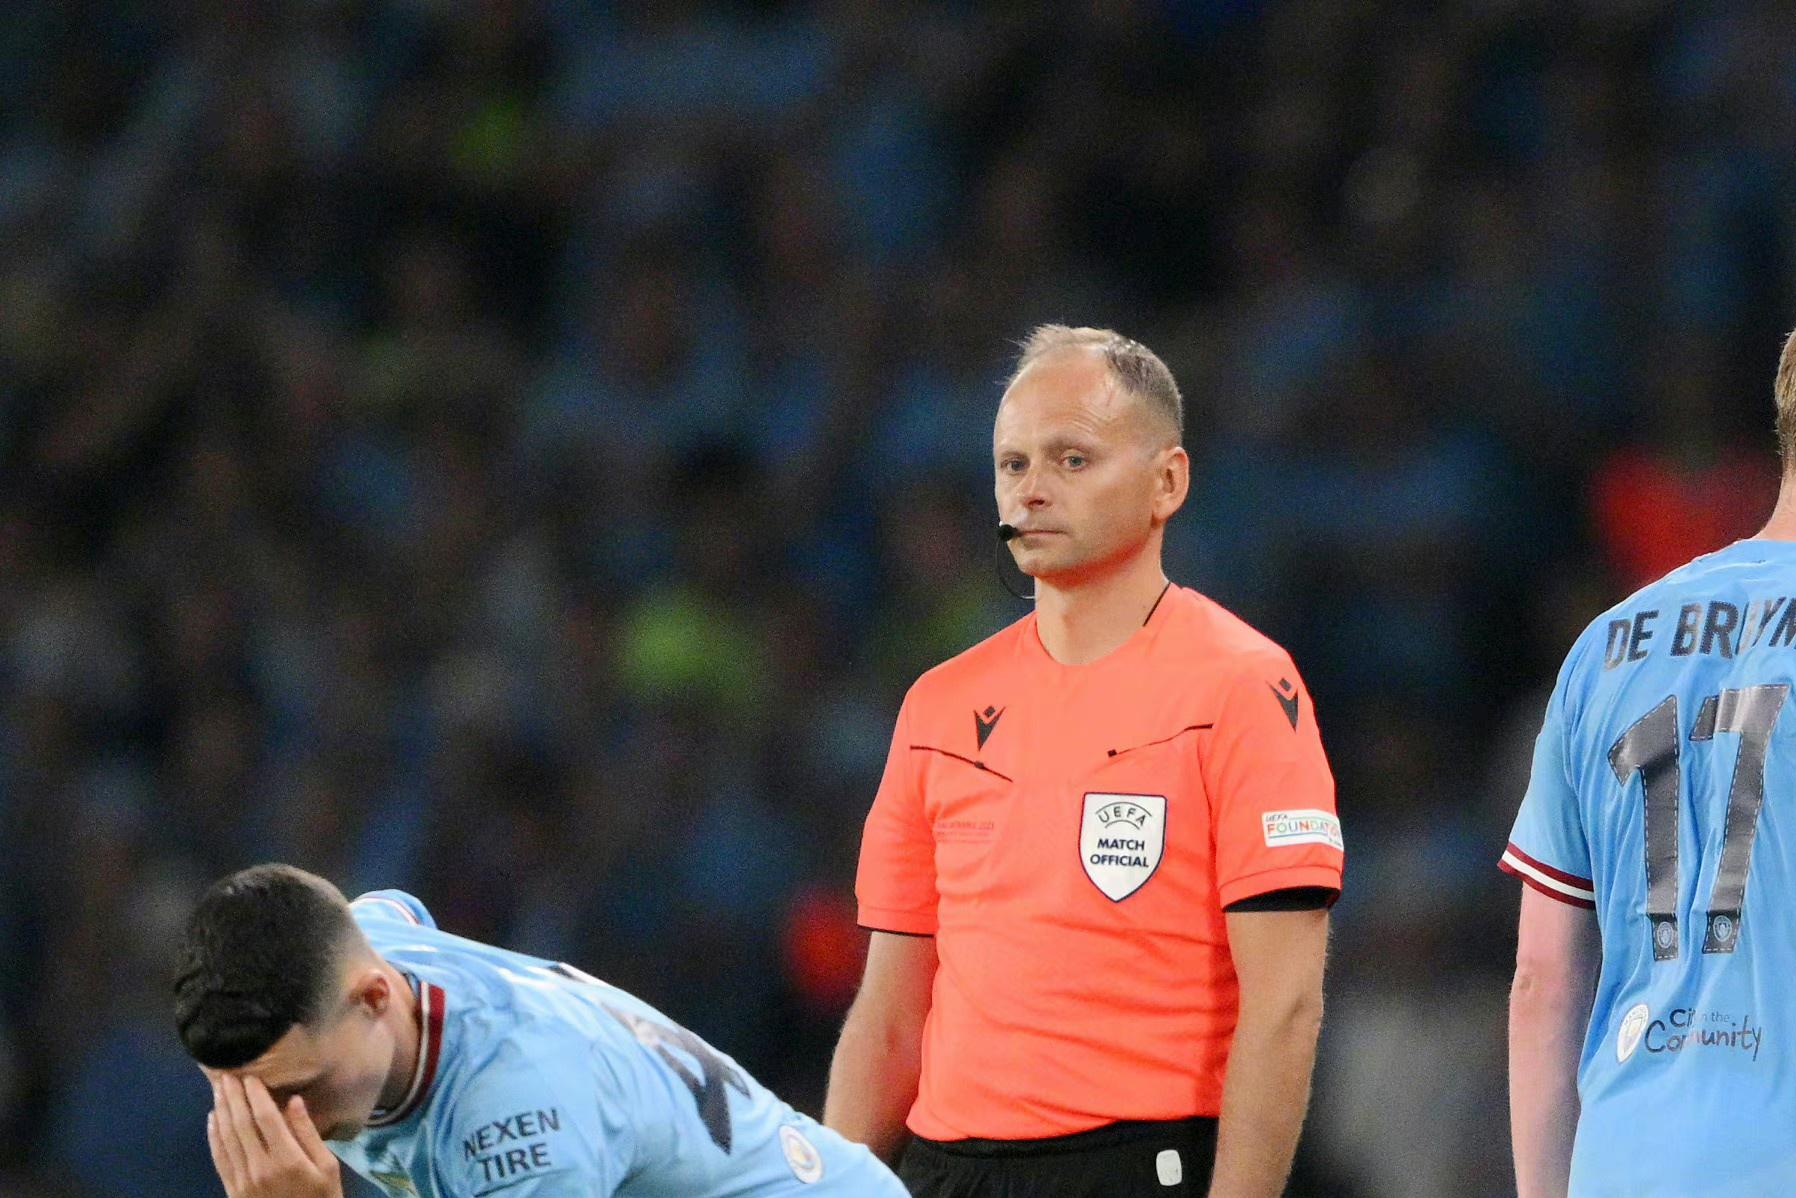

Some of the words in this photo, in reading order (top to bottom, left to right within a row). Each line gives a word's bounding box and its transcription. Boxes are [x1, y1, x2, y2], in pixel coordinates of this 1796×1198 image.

[1604, 609, 1659, 671] DE
[1098, 805, 1147, 827] UEFA
[1607, 683, 1792, 962] 17
[1090, 853, 1149, 868] OFFICIAL
[1097, 838, 1145, 851] MATCH
[1644, 1015, 1762, 1062] Counity
[462, 1106, 561, 1162] NEXEN
[477, 1142, 552, 1182] TIRE
